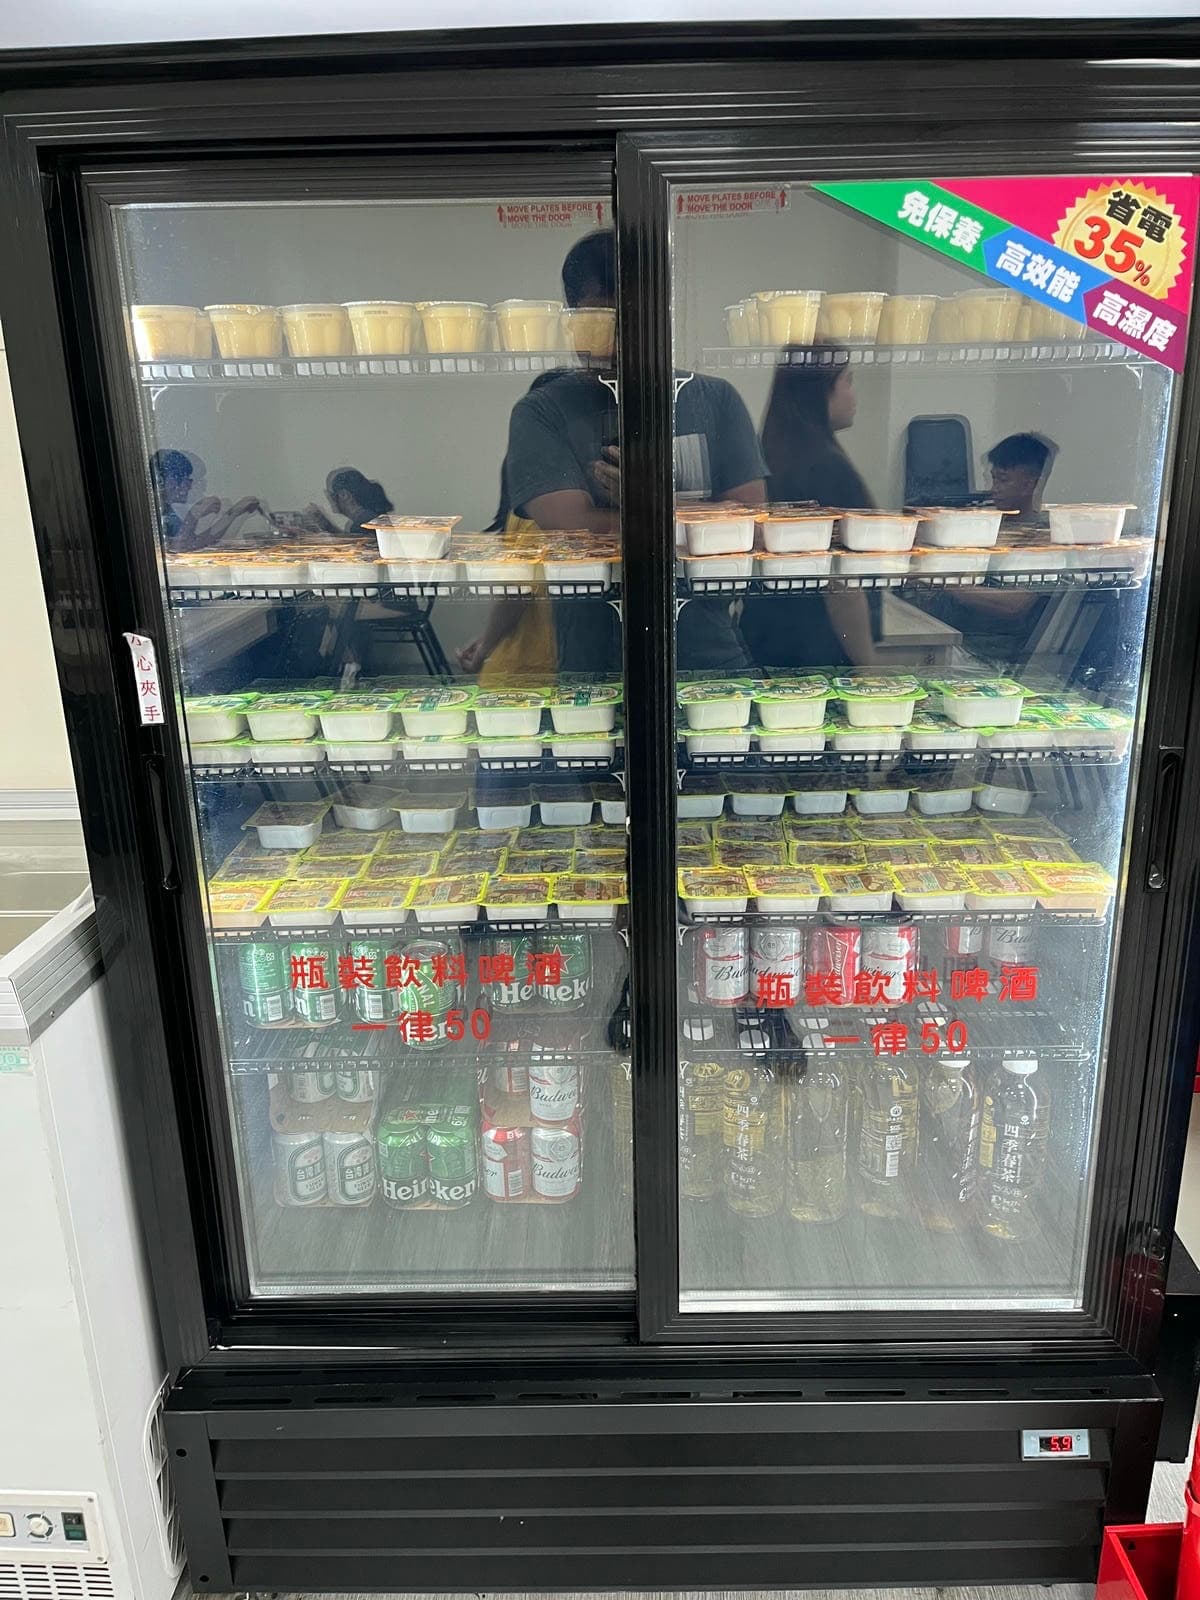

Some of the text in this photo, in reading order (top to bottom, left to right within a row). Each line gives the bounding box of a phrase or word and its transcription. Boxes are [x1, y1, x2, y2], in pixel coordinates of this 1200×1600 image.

[507, 202, 593, 213] MOVE PLATES BEFORE
[687, 191, 776, 202] MOVE PLATES BEFORE
[687, 203, 710, 213] MOVE
[730, 202, 753, 210] DOOR
[1106, 190, 1173, 243] 省電
[507, 215, 529, 224] MOVE
[548, 213, 571, 221] DOOR
[897, 190, 984, 254] 免保養
[1074, 216, 1152, 286] 35%
[995, 240, 1081, 303] 高效能
[290, 952, 561, 990] 瓶裝飲料啤酒
[756, 966, 1039, 1008] 瓶裝飲料啤酒
